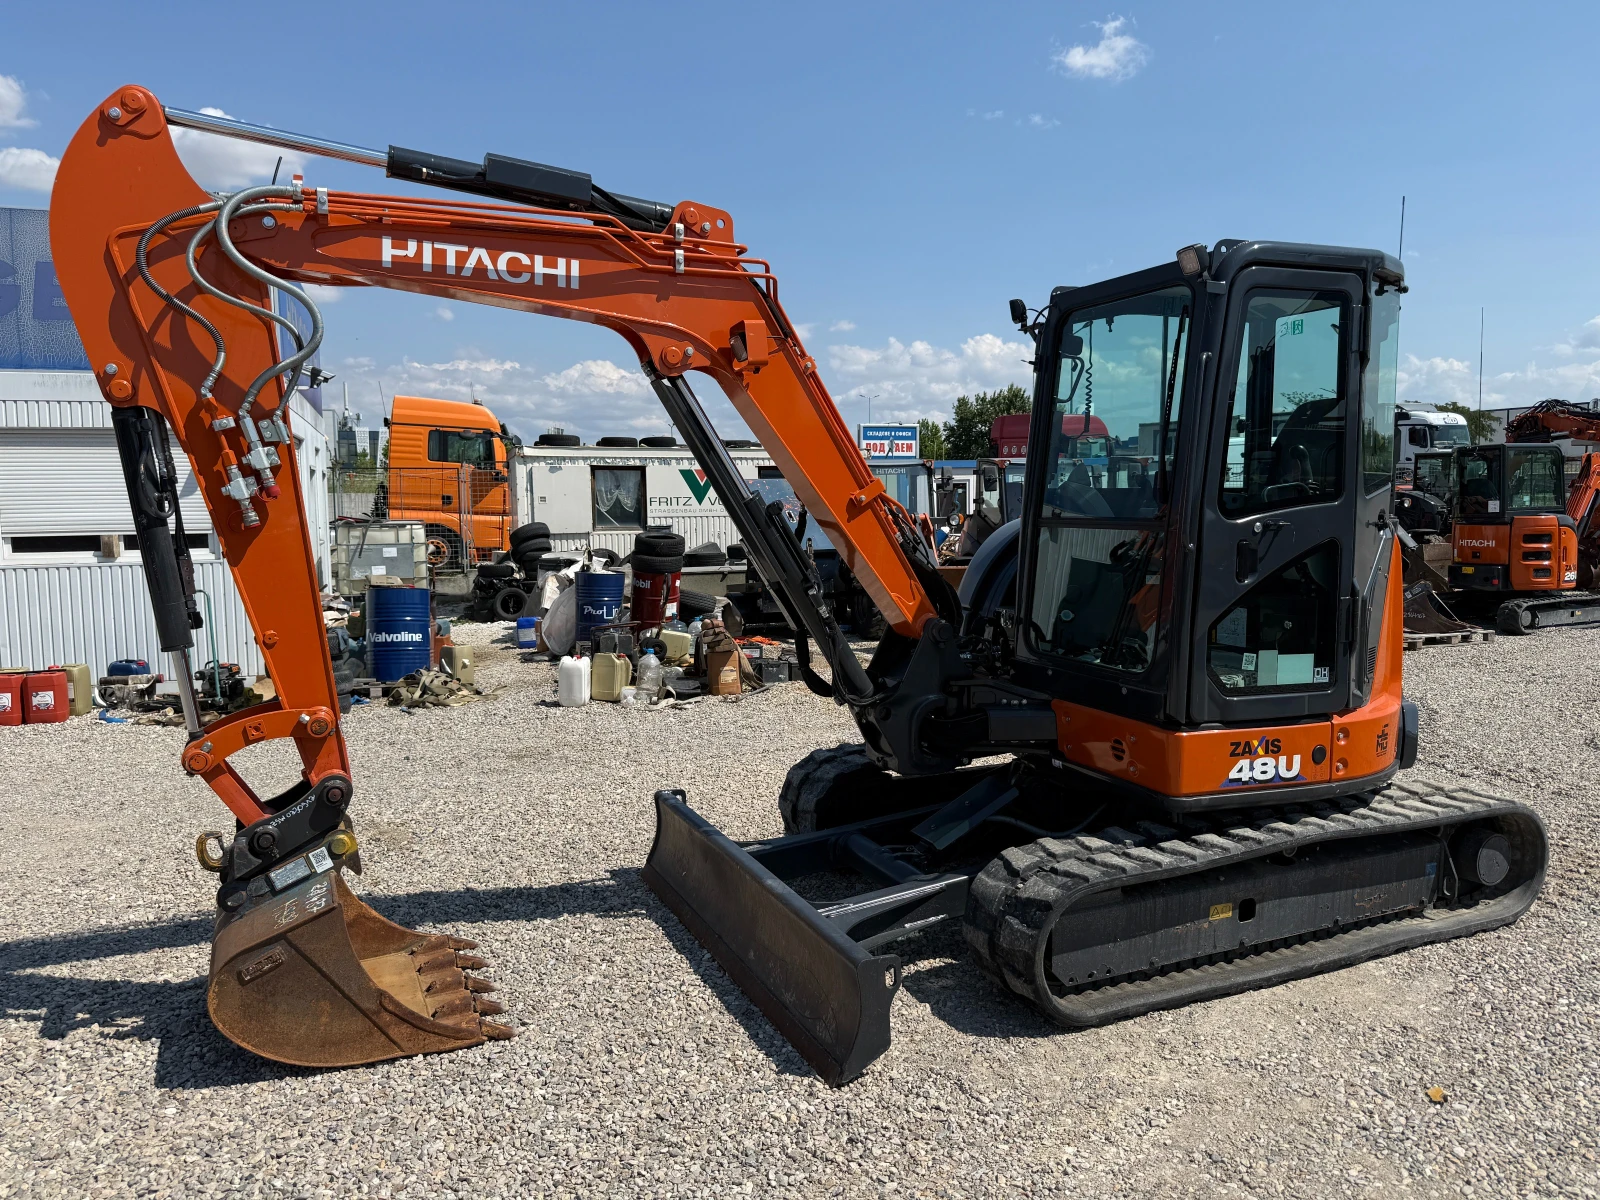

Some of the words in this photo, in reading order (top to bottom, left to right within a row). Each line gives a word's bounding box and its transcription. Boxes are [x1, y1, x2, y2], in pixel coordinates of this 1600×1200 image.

[381, 235, 580, 290] HITACHI
[865, 442, 886, 454] ПОД
[894, 442, 913, 453] АЕМ
[649, 496, 693, 507] FRITZ
[1459, 539, 1496, 548] HITACHI
[369, 631, 423, 643] Valvoline
[1229, 735, 1282, 758] ZAXIS
[1228, 754, 1301, 783] 48U
